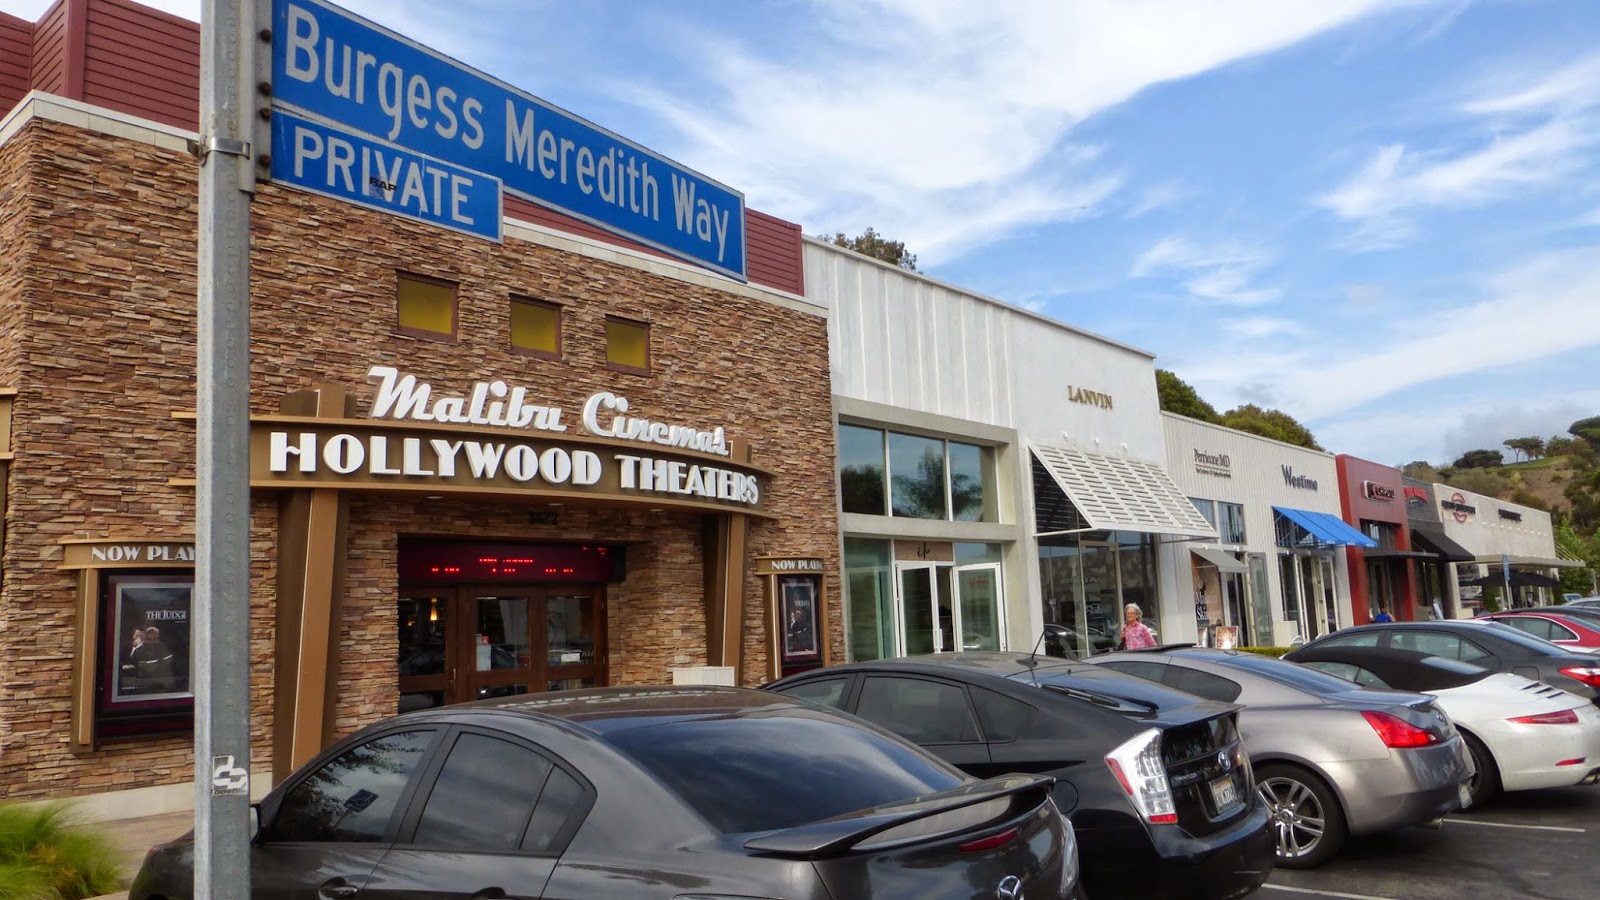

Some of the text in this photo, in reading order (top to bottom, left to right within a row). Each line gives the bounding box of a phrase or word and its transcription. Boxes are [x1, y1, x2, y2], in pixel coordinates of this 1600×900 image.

[285, 4, 729, 263] Burgess Meredith Way
[294, 125, 475, 226] PRIVATE
[367, 366, 730, 456] Malibu Cinemas
[1067, 385, 1113, 410] LANVIN
[269, 432, 760, 505] HOLLYWOOD THEATERS
[91, 546, 141, 561] NOW
[771, 560, 796, 570] NOW
[145, 611, 163, 620] THE
